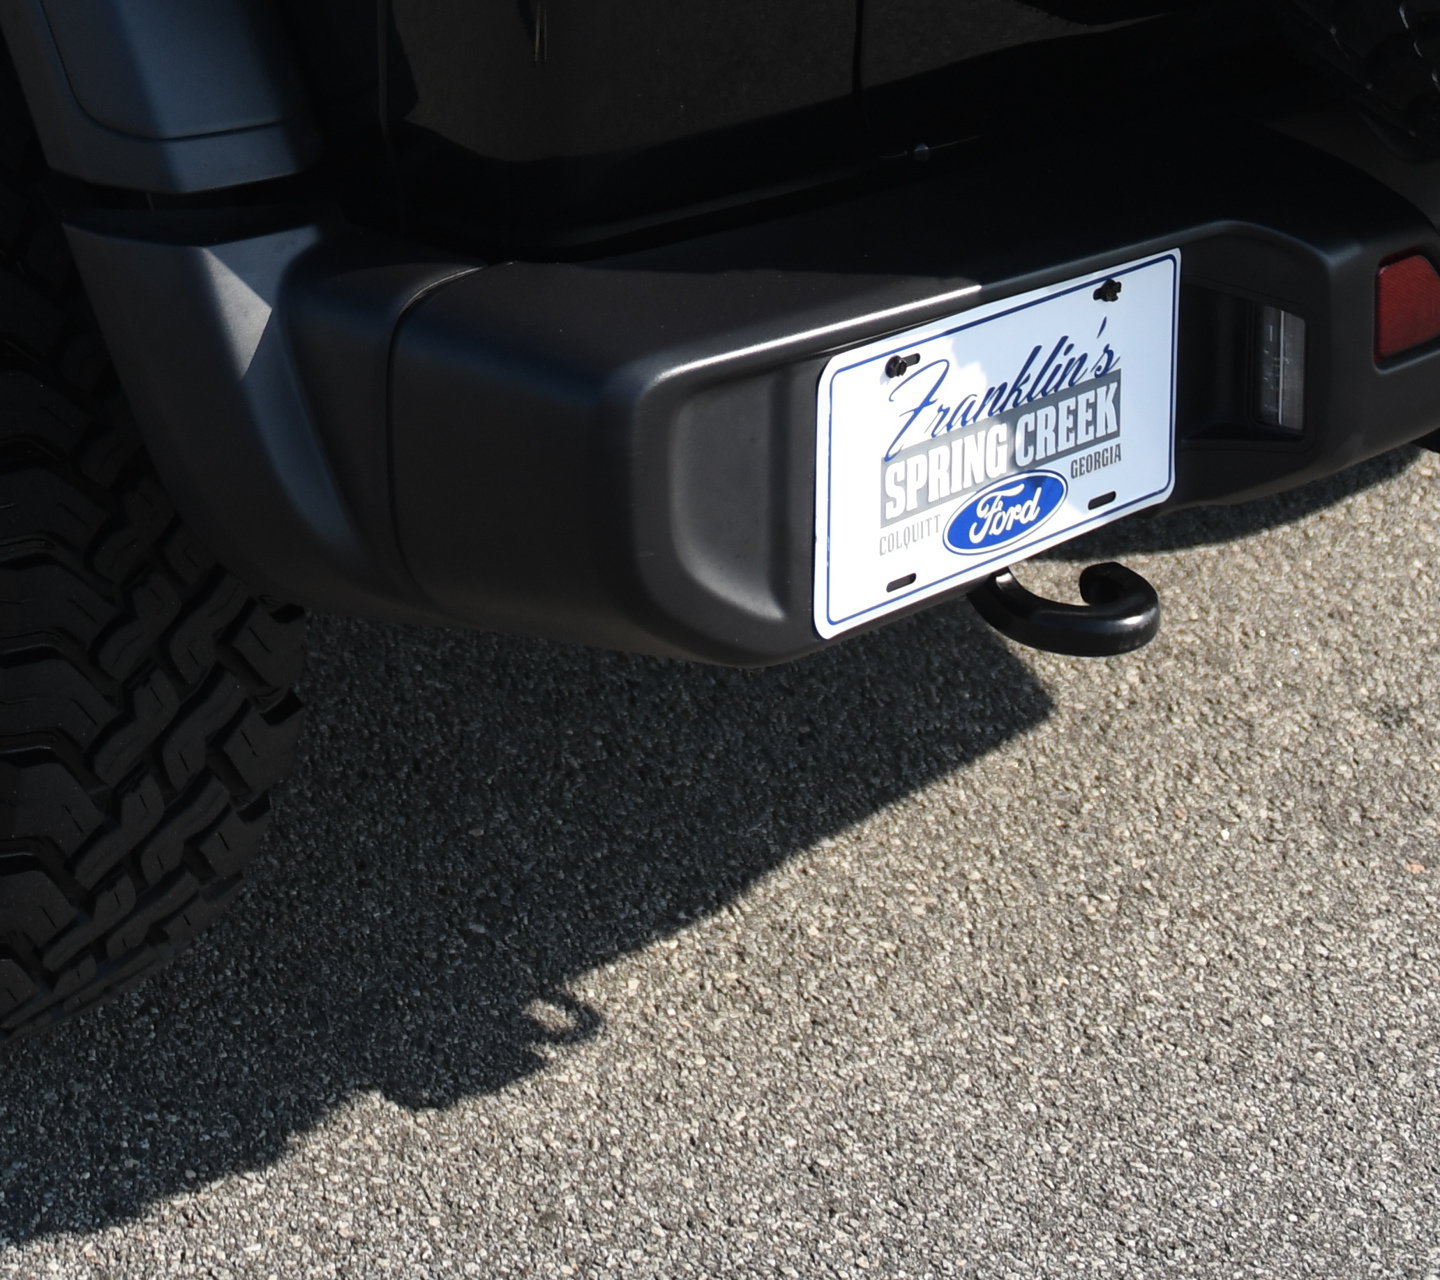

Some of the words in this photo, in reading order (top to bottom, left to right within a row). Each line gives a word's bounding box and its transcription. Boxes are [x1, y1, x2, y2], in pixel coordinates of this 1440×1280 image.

[884, 316, 1121, 462] Franklin's
[884, 422, 1009, 521] SPRING
[1015, 381, 1120, 468] CREEK
[1069, 443, 1123, 479] GEORGIA
[879, 513, 941, 557] COLQUITT
[969, 483, 1041, 545] Ford
